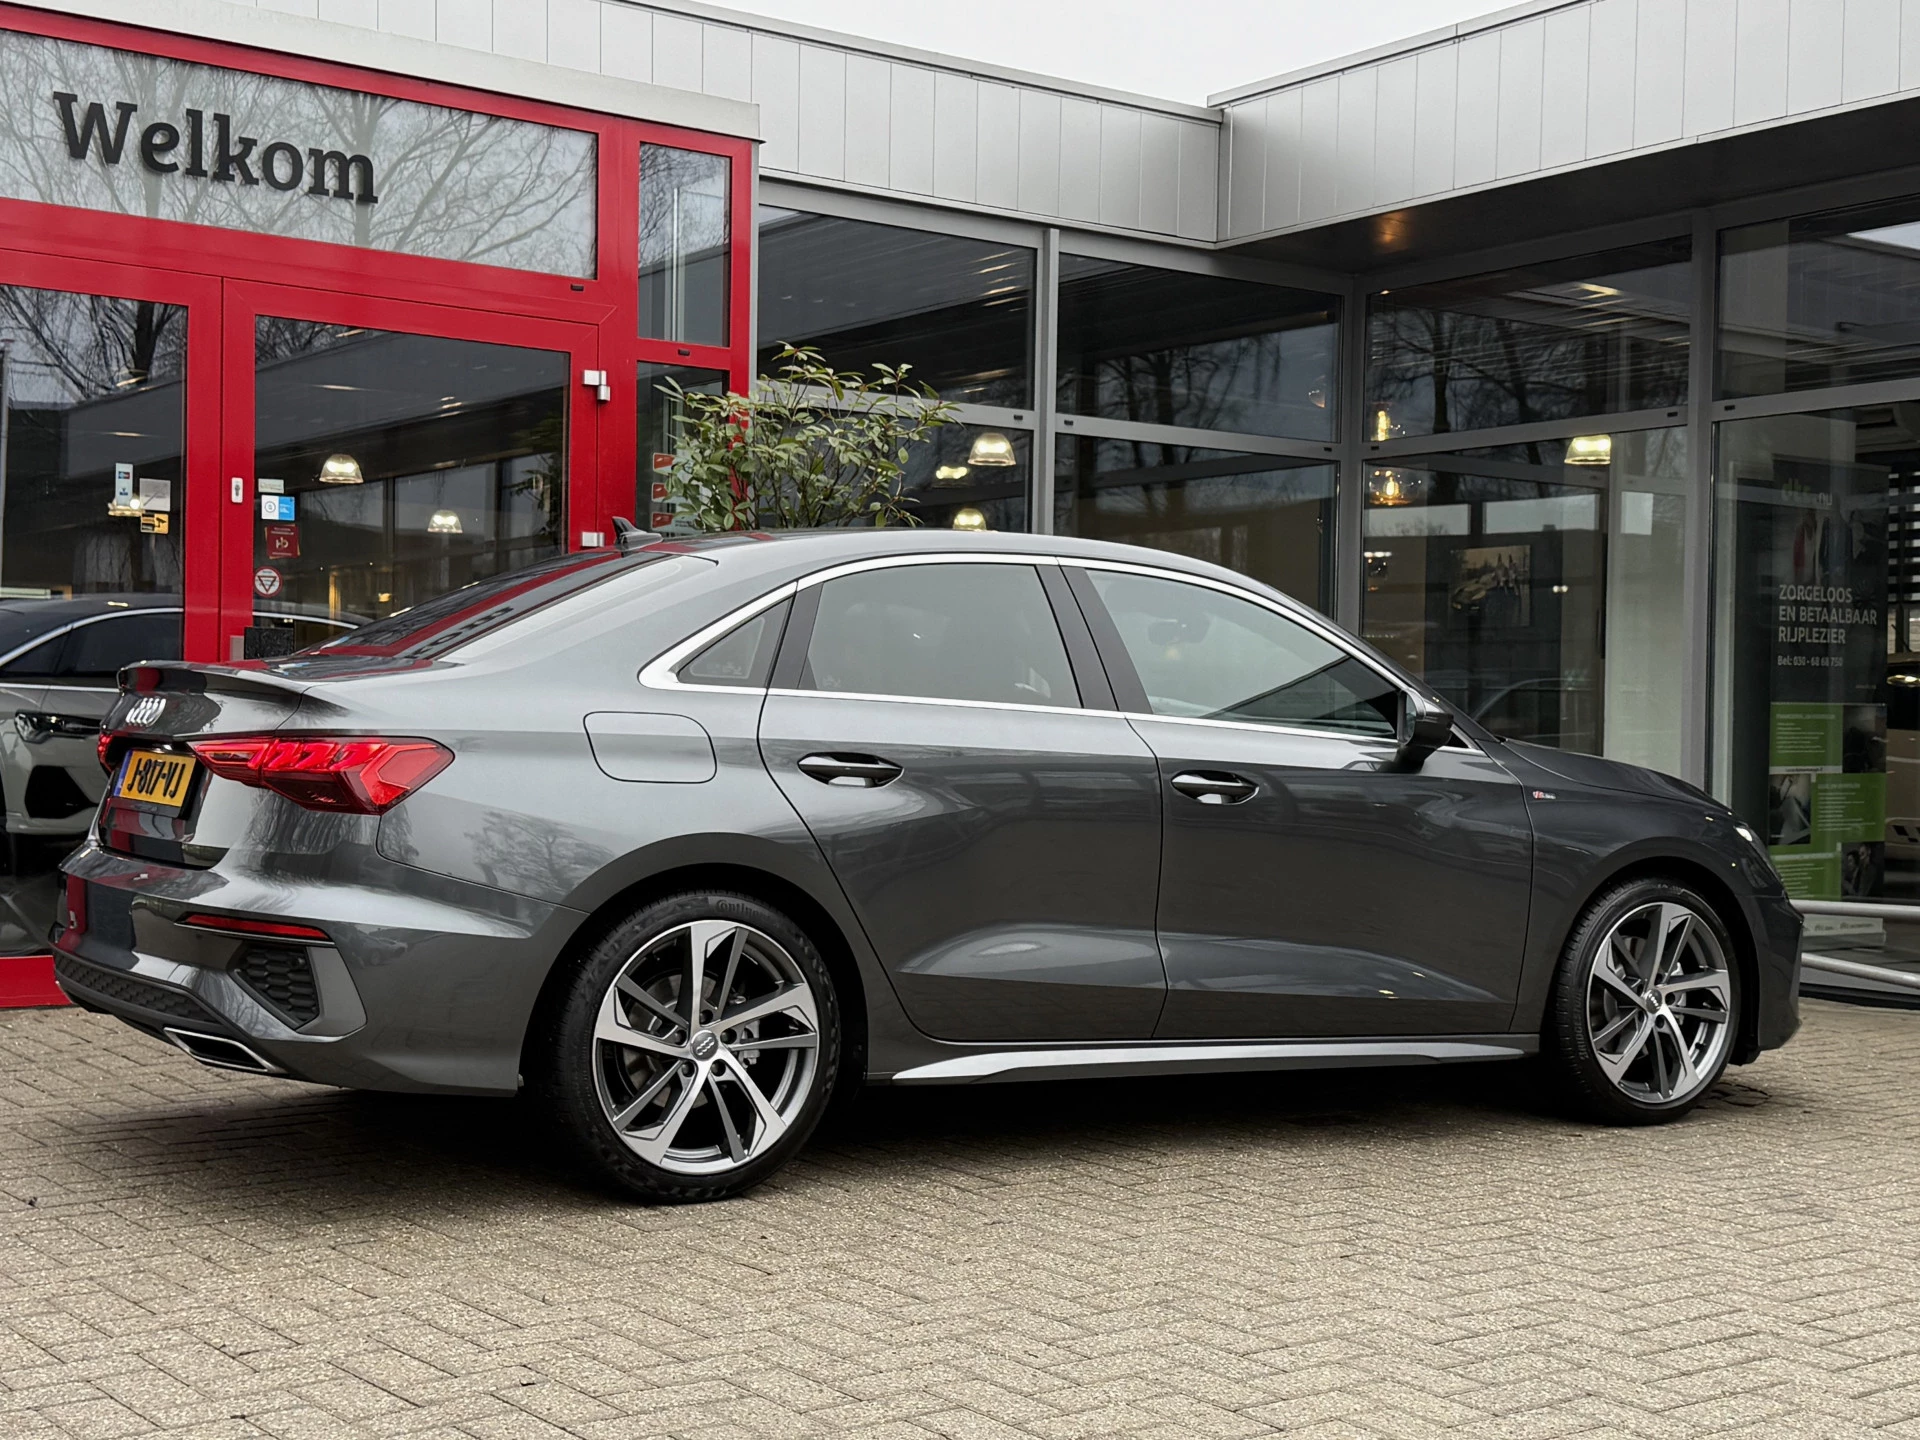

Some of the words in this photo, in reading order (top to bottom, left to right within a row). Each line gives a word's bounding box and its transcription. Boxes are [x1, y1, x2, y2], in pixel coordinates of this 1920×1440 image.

[53, 91, 378, 204] Welkom
[1779, 584, 1853, 603] ZORGELOOS
[1778, 605, 1796, 622] EN
[1799, 606, 1877, 625] BETAALBAAR
[1778, 626, 1846, 644] RIJPLEZIER
[127, 758, 186, 799] J-817-VJ
